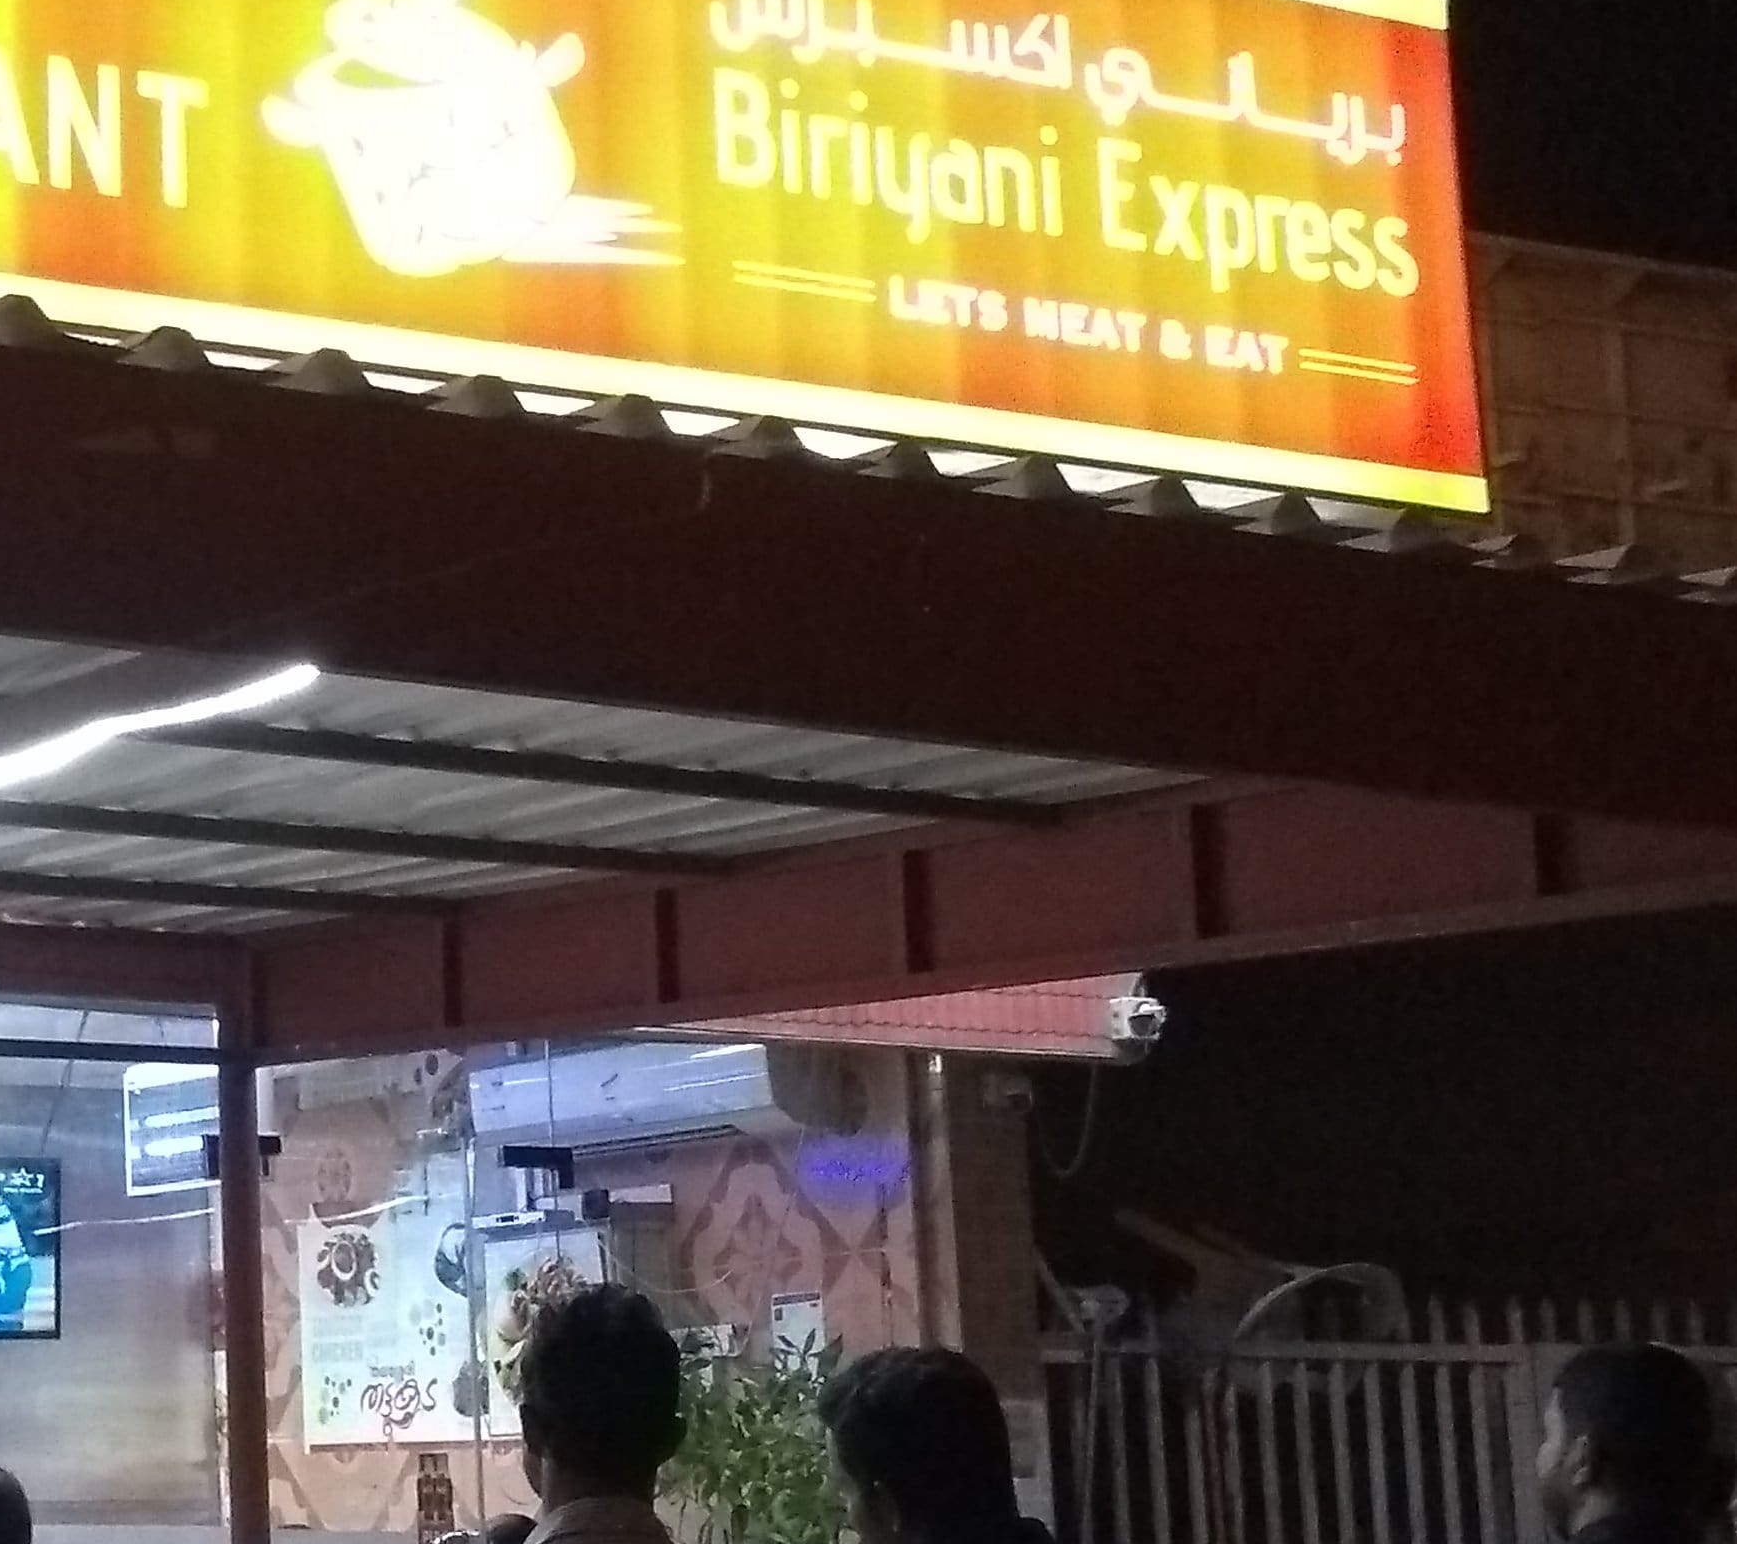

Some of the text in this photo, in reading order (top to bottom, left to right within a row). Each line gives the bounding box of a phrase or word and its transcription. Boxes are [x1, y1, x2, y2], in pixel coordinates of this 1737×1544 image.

[713, 67, 1421, 297] Biriyani Express
[887, 274, 1290, 375] LETS MEAT & EAT
